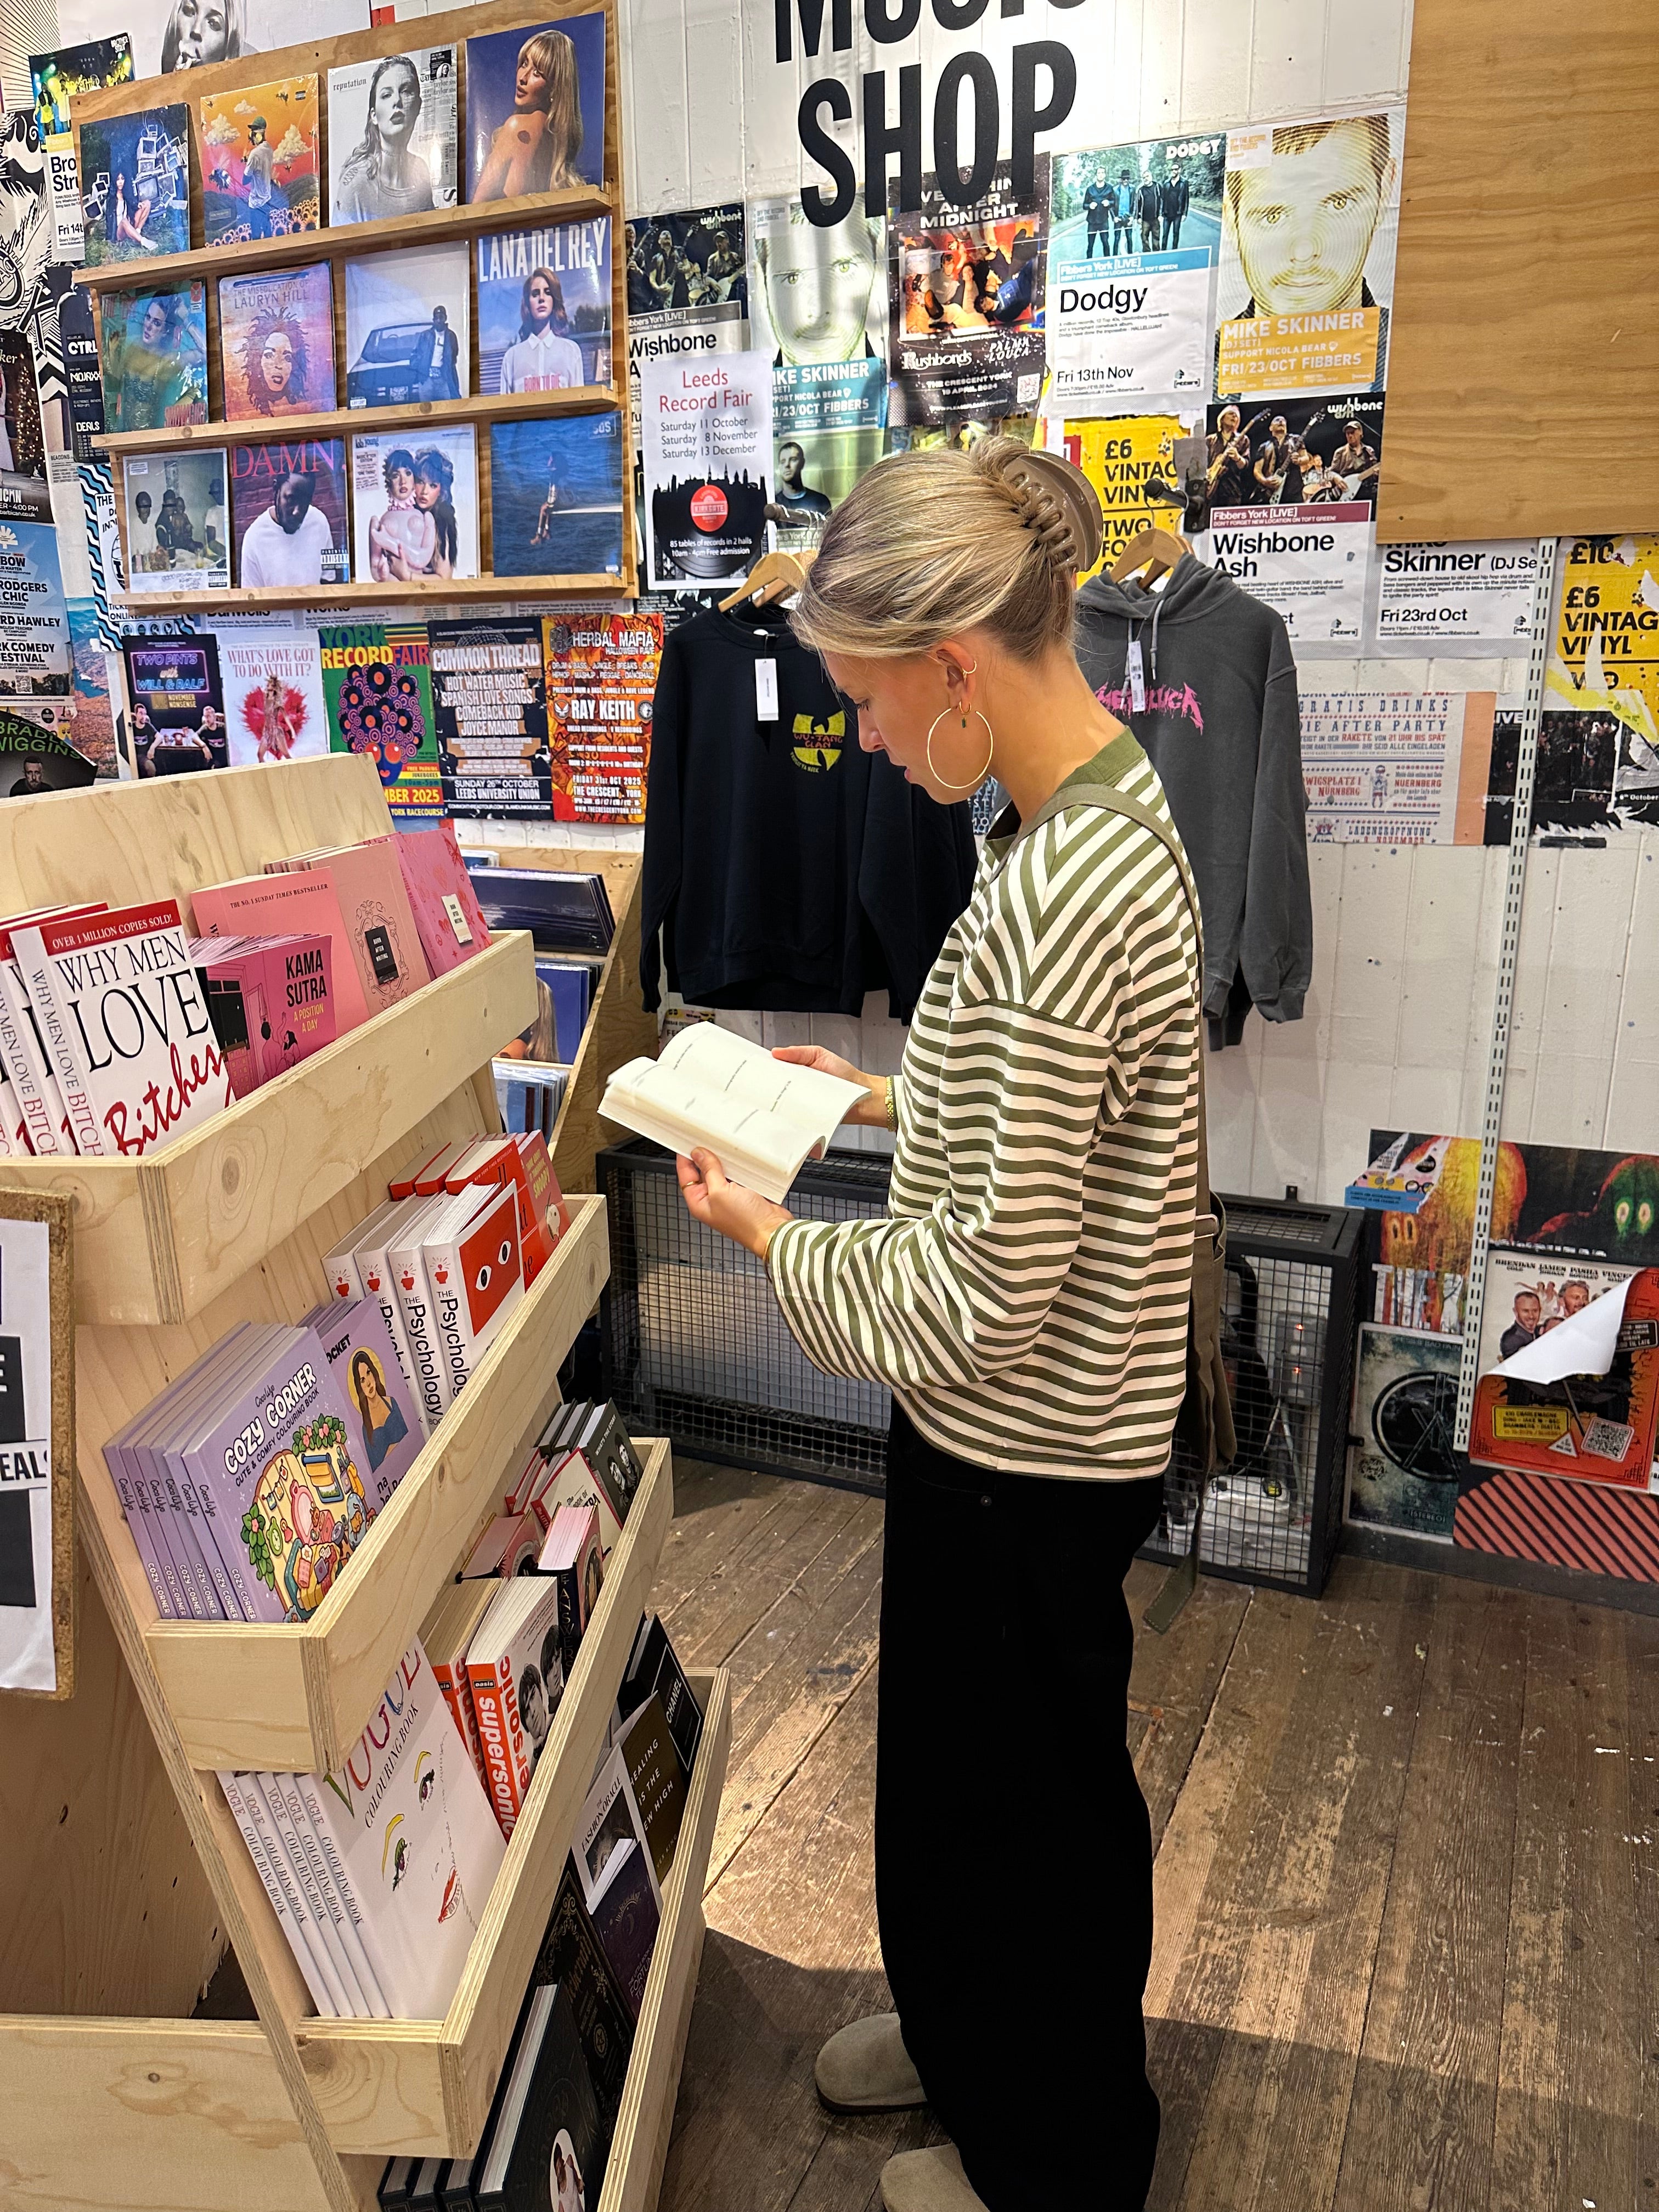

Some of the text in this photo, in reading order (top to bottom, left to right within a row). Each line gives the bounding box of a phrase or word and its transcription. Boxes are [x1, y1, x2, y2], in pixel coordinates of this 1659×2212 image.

[333, 77, 367, 91] reputation
[798, 41, 1076, 228] SHOP
[1165, 139, 1221, 160] DODGY
[920, 204, 1019, 229] MIDNIGHT
[478, 218, 607, 282] LANA DEL REY
[234, 287, 308, 309] LAURYN HILL
[1059, 285, 1147, 314] Dodgy
[1223, 312, 1364, 338] MIKE SKINNER
[68, 341, 98, 356] CTRL
[629, 332, 717, 358] Wishbone
[1222, 343, 1327, 360] SUPPORT NICOLA BEAR
[801, 363, 869, 383] SKINNER
[1057, 366, 1134, 383] Fri 13th Nov
[1221, 353, 1362, 376] FRI/23/OCT FIBBERS
[682, 368, 728, 388] Leeds
[659, 392, 753, 413] Record Fair
[824, 399, 868, 413] FIBBERS
[1328, 397, 1383, 413] wishbone
[76, 422, 99, 432] DEALS
[661, 417, 748, 432] Saturday 11 October
[661, 431, 758, 445] Saturday 8 November
[232, 439, 347, 478] DAMN.
[663, 444, 756, 459] Saturday 13 December
[1105, 439, 1132, 459] £6
[1214, 507, 1297, 520] Fibbers York [LIVE]
[1212, 533, 1334, 554] Wishbone
[1215, 557, 1257, 577] Ash
[1385, 550, 1486, 572] Skinner
[1490, 557, 1515, 571] (DJ
[2, 591, 29, 602] CHIC
[1567, 586, 1600, 608] £6
[18, 616, 60, 627] HAWLEY
[1380, 608, 1468, 622] Fri 23rd Oct
[319, 625, 386, 648] YORK
[573, 631, 654, 647] HERBAL MAFIA
[12, 642, 54, 652] COMEDY
[227, 647, 315, 664] WHAT'S LOVE GOT
[321, 646, 429, 668] RECORD FAIR
[137, 654, 197, 665] TWO PINTS
[433, 645, 540, 670] COMMON THREAD
[233, 663, 311, 677] TO DO WITH IT?
[137, 678, 205, 690] WILL & RALF
[447, 674, 525, 691] HOT WATER MUSIC
[441, 689, 533, 707] SPANISH LOVE SONGS
[1380, 699, 1448, 712] DRINKS
[455, 705, 522, 720] COMEBACK KID
[571, 700, 635, 719] RAY KEITH
[1332, 720, 1446, 732] AFTER PARTY
[793, 735, 843, 743] WU-TANG
[1395, 779, 1442, 788] NUERNBERG
[412, 789, 439, 803] 2025
[391, 808, 444, 817] YORK RACECOURSE
[255, 894, 274, 905] SUNDAY
[275, 891, 292, 899] TIMES
[294, 883, 328, 896] BESTSELLER
[52, 914, 173, 950] OVER 1 MILLION COPIES SOLD!
[374, 945, 383, 953] AFTER
[375, 952, 388, 962] WRITING
[55, 932, 186, 994] WHY MEN
[285, 949, 324, 980] KAMA
[286, 975, 327, 1007] SUTRA
[67, 968, 208, 1073] LOVE
[294, 1003, 324, 1021] A POSITION
[302, 1020, 318, 1033] A DAY
[104, 1043, 223, 1156] Bitches
[533, 1166, 550, 1199] SNOOPY
[403, 1296, 421, 1305] THE
[436, 1290, 454, 1299] THE
[407, 1304, 443, 1416] Psychology
[224, 1362, 317, 1475] COZY CORNER
[235, 1388, 319, 1488] CUTE & COMFY COLOURING BOOK
[665, 1680, 682, 1724] CHANEL
[364, 1703, 420, 1829] COLOURING BOOK
[478, 1695, 516, 1835] supersonic
[638, 1767, 661, 1806] IS THE
[654, 1780, 674, 1812] HIGH
[581, 1775, 622, 1853] FASHION ORACLE
